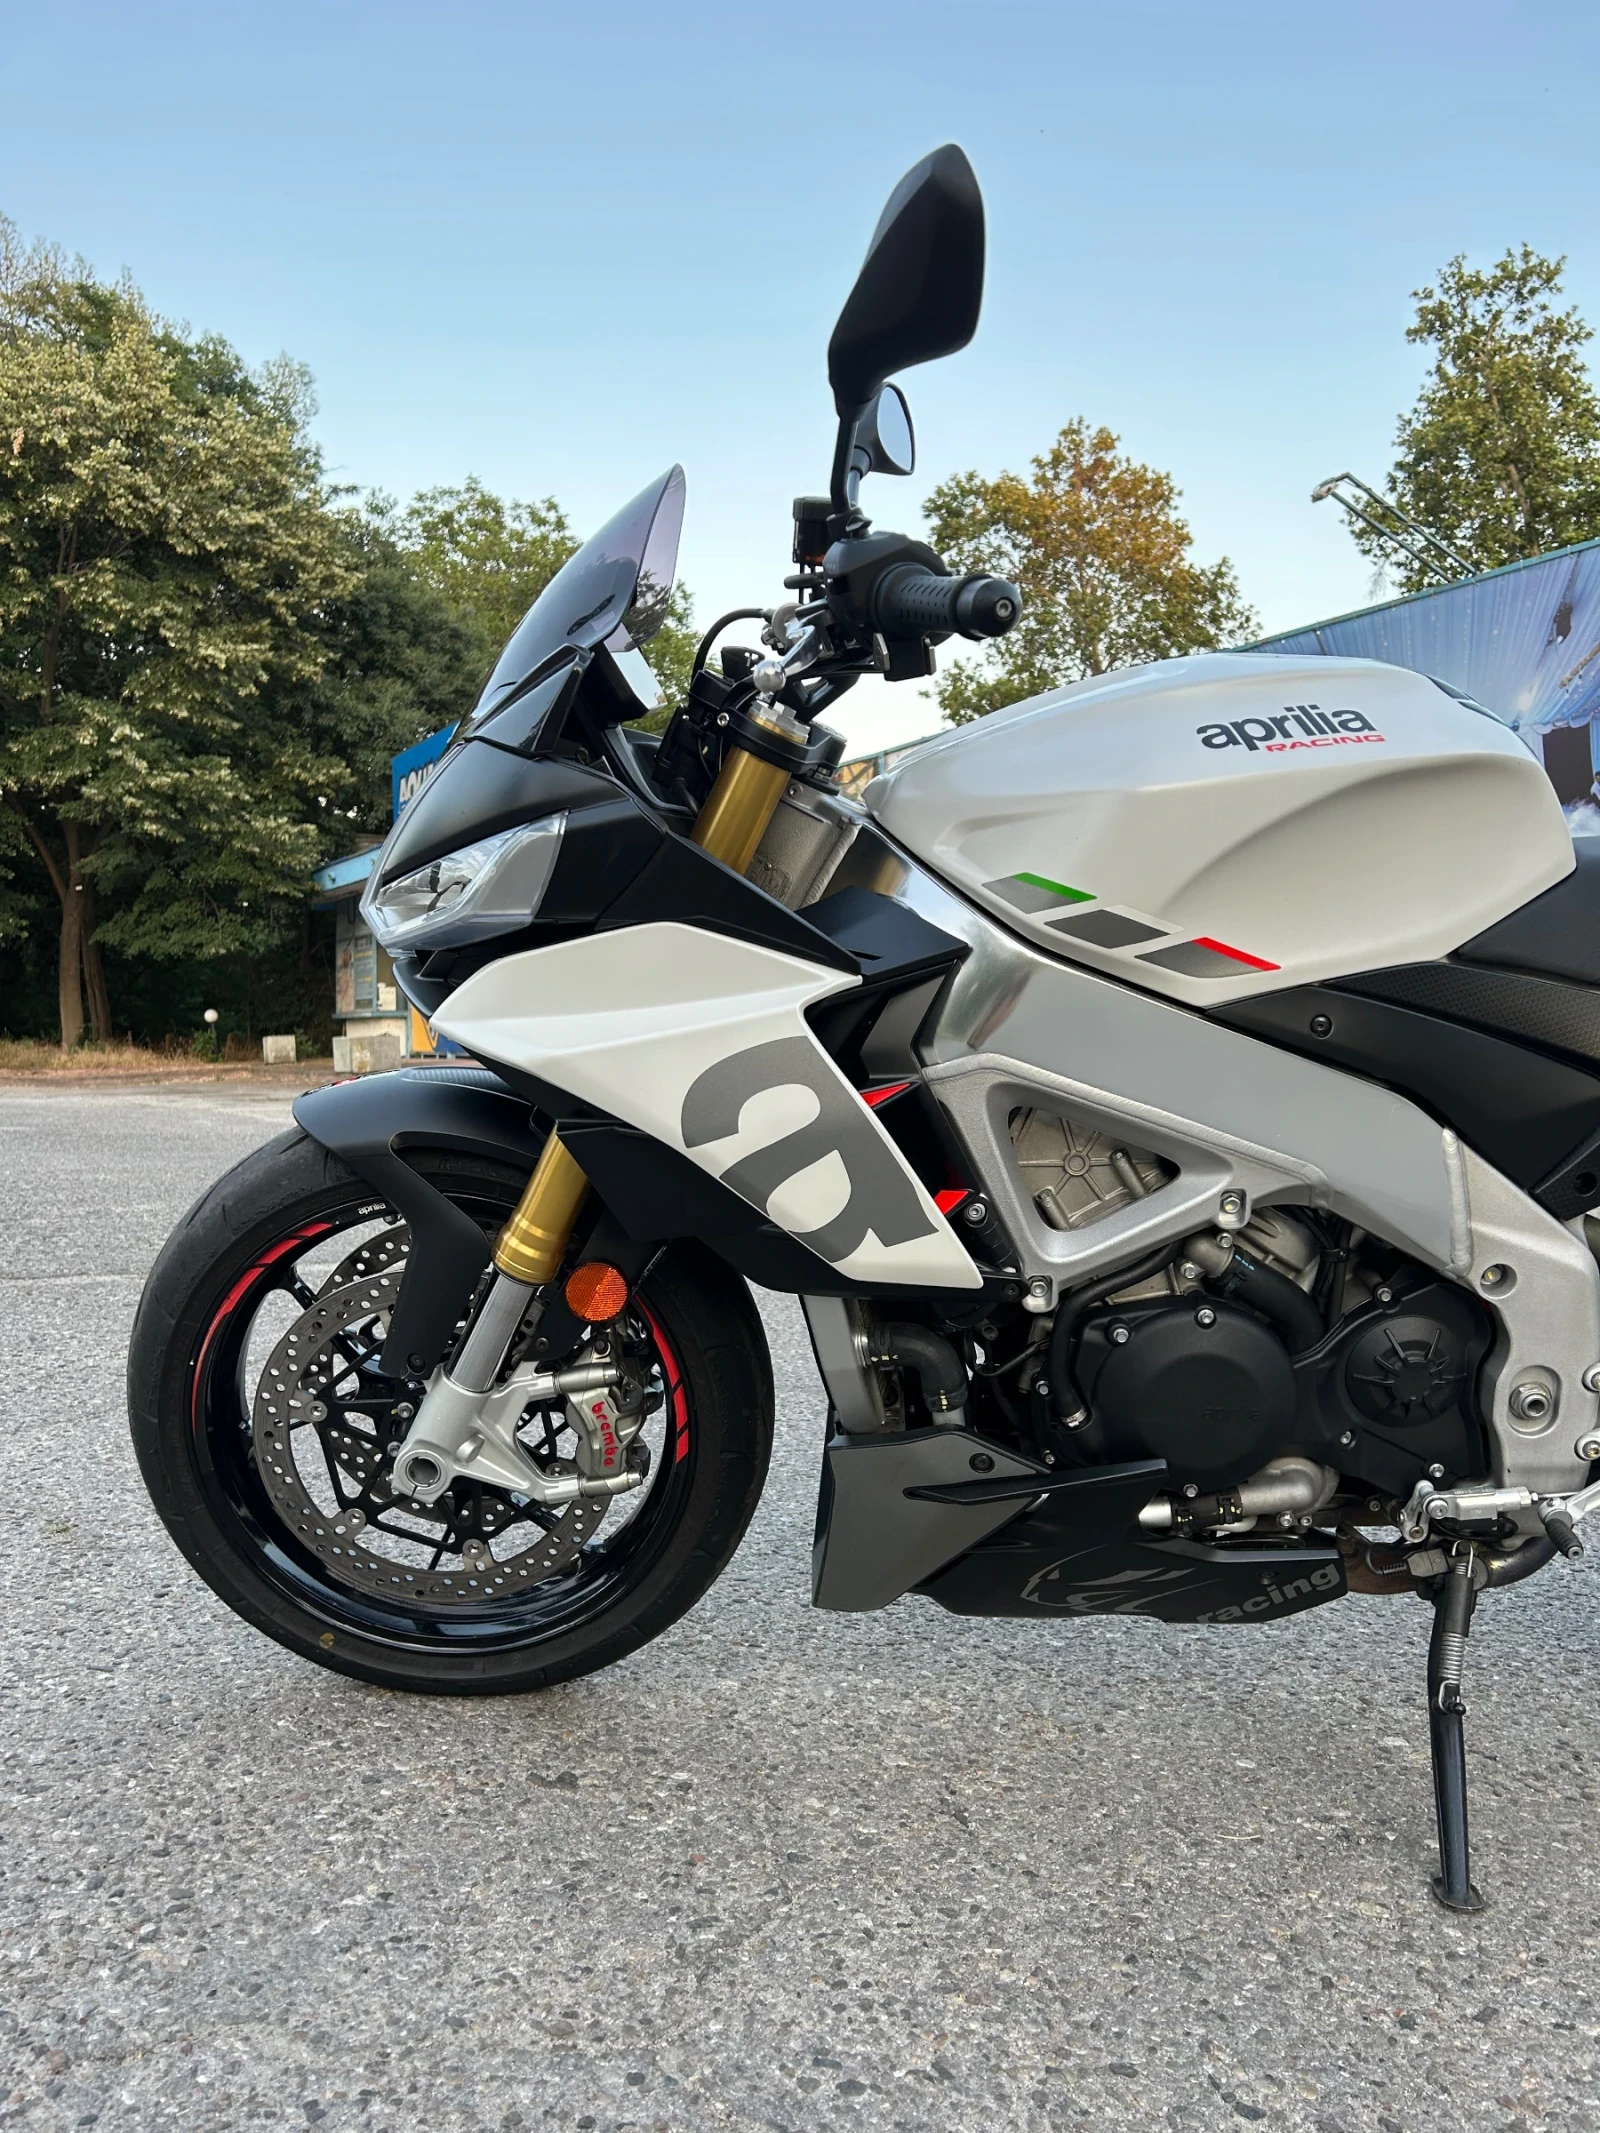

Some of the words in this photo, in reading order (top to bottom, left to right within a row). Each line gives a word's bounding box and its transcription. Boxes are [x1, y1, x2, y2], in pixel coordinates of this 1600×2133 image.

[1196, 704, 1377, 751] aprilia
[1265, 734, 1386, 752] RACING
[591, 1401, 619, 1468] brembo
[1196, 1563, 1340, 1624] racing
